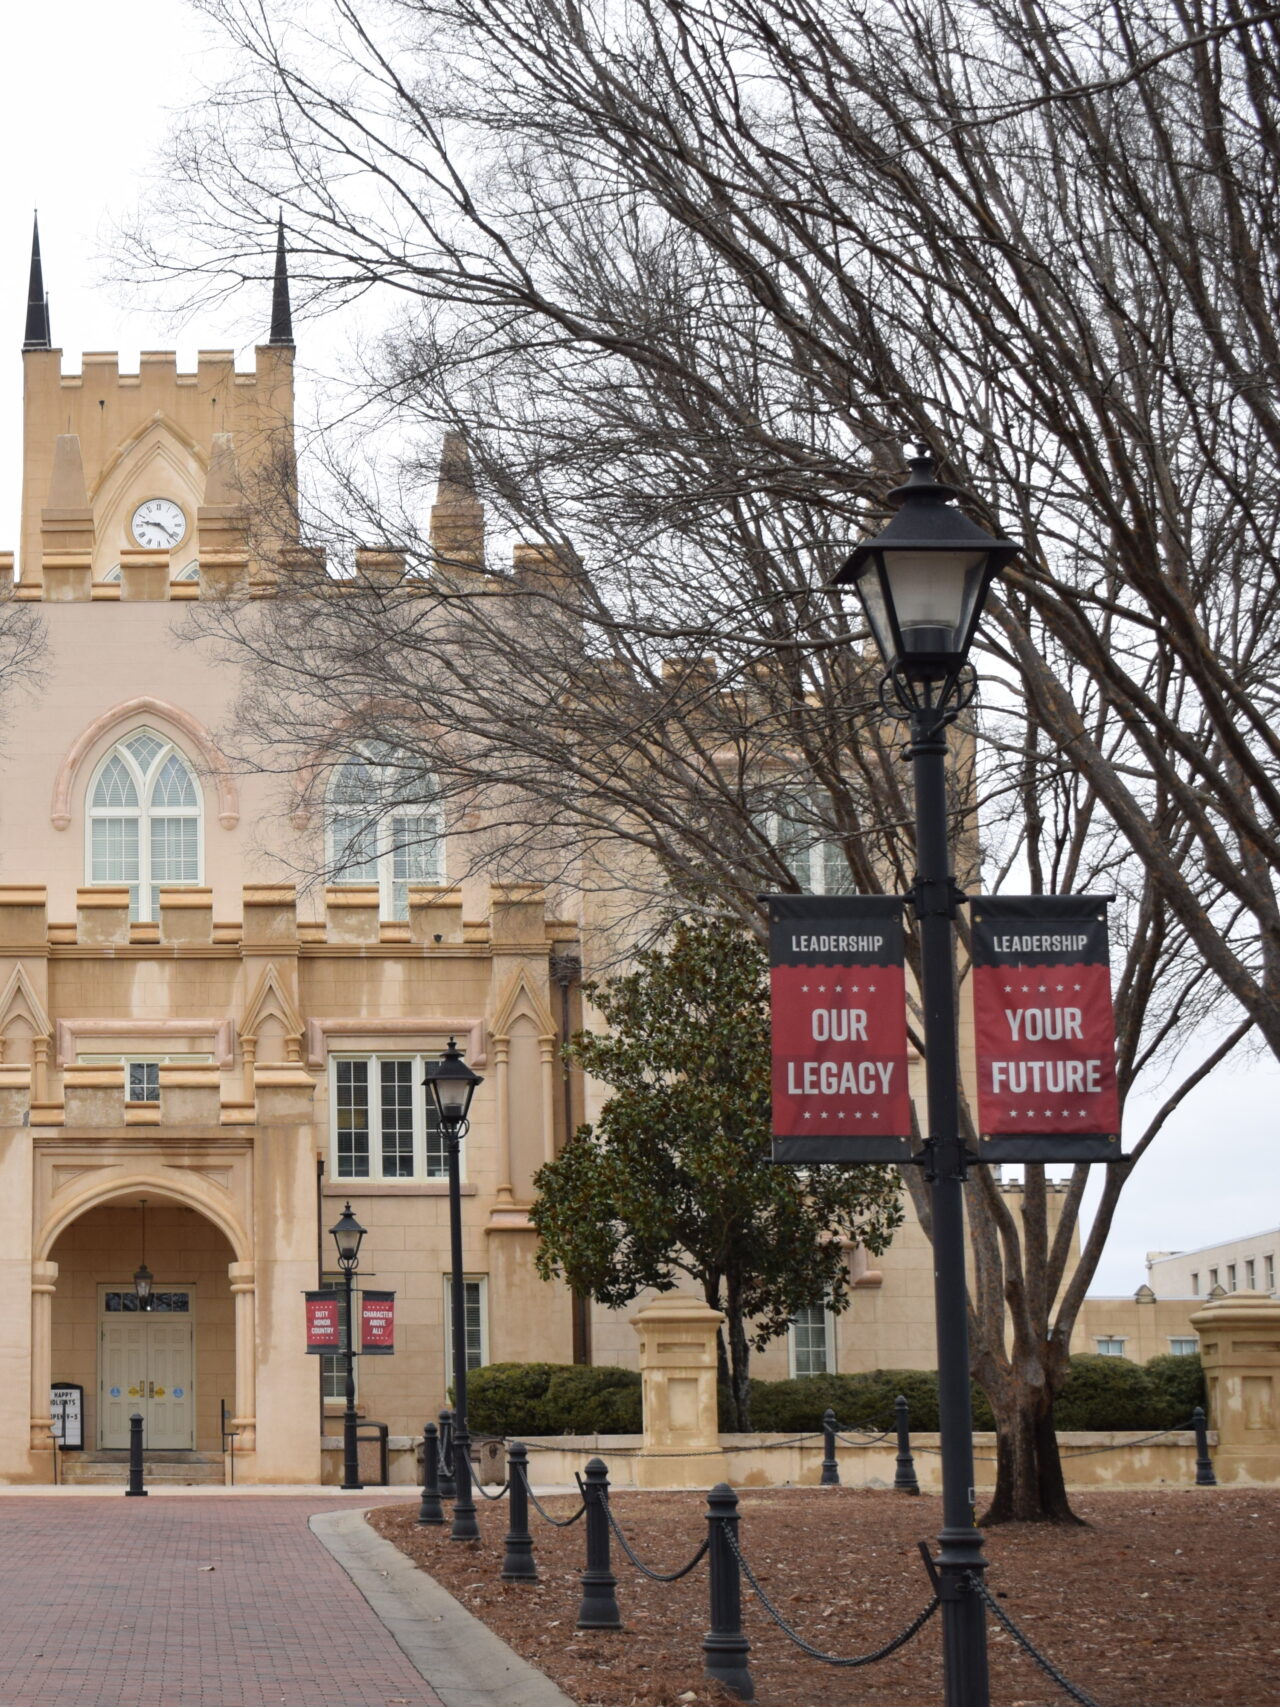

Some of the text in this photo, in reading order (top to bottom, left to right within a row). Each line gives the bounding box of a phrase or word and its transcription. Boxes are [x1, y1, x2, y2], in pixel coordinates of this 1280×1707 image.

[792, 935, 883, 952] LEADERSHIP
[993, 934, 1088, 953] LEADERSHIP
[811, 1008, 868, 1042] OUR
[1005, 1007, 1084, 1042] YOUR
[787, 1061, 894, 1095] LEGACY
[991, 1059, 1103, 1094] FUTURE
